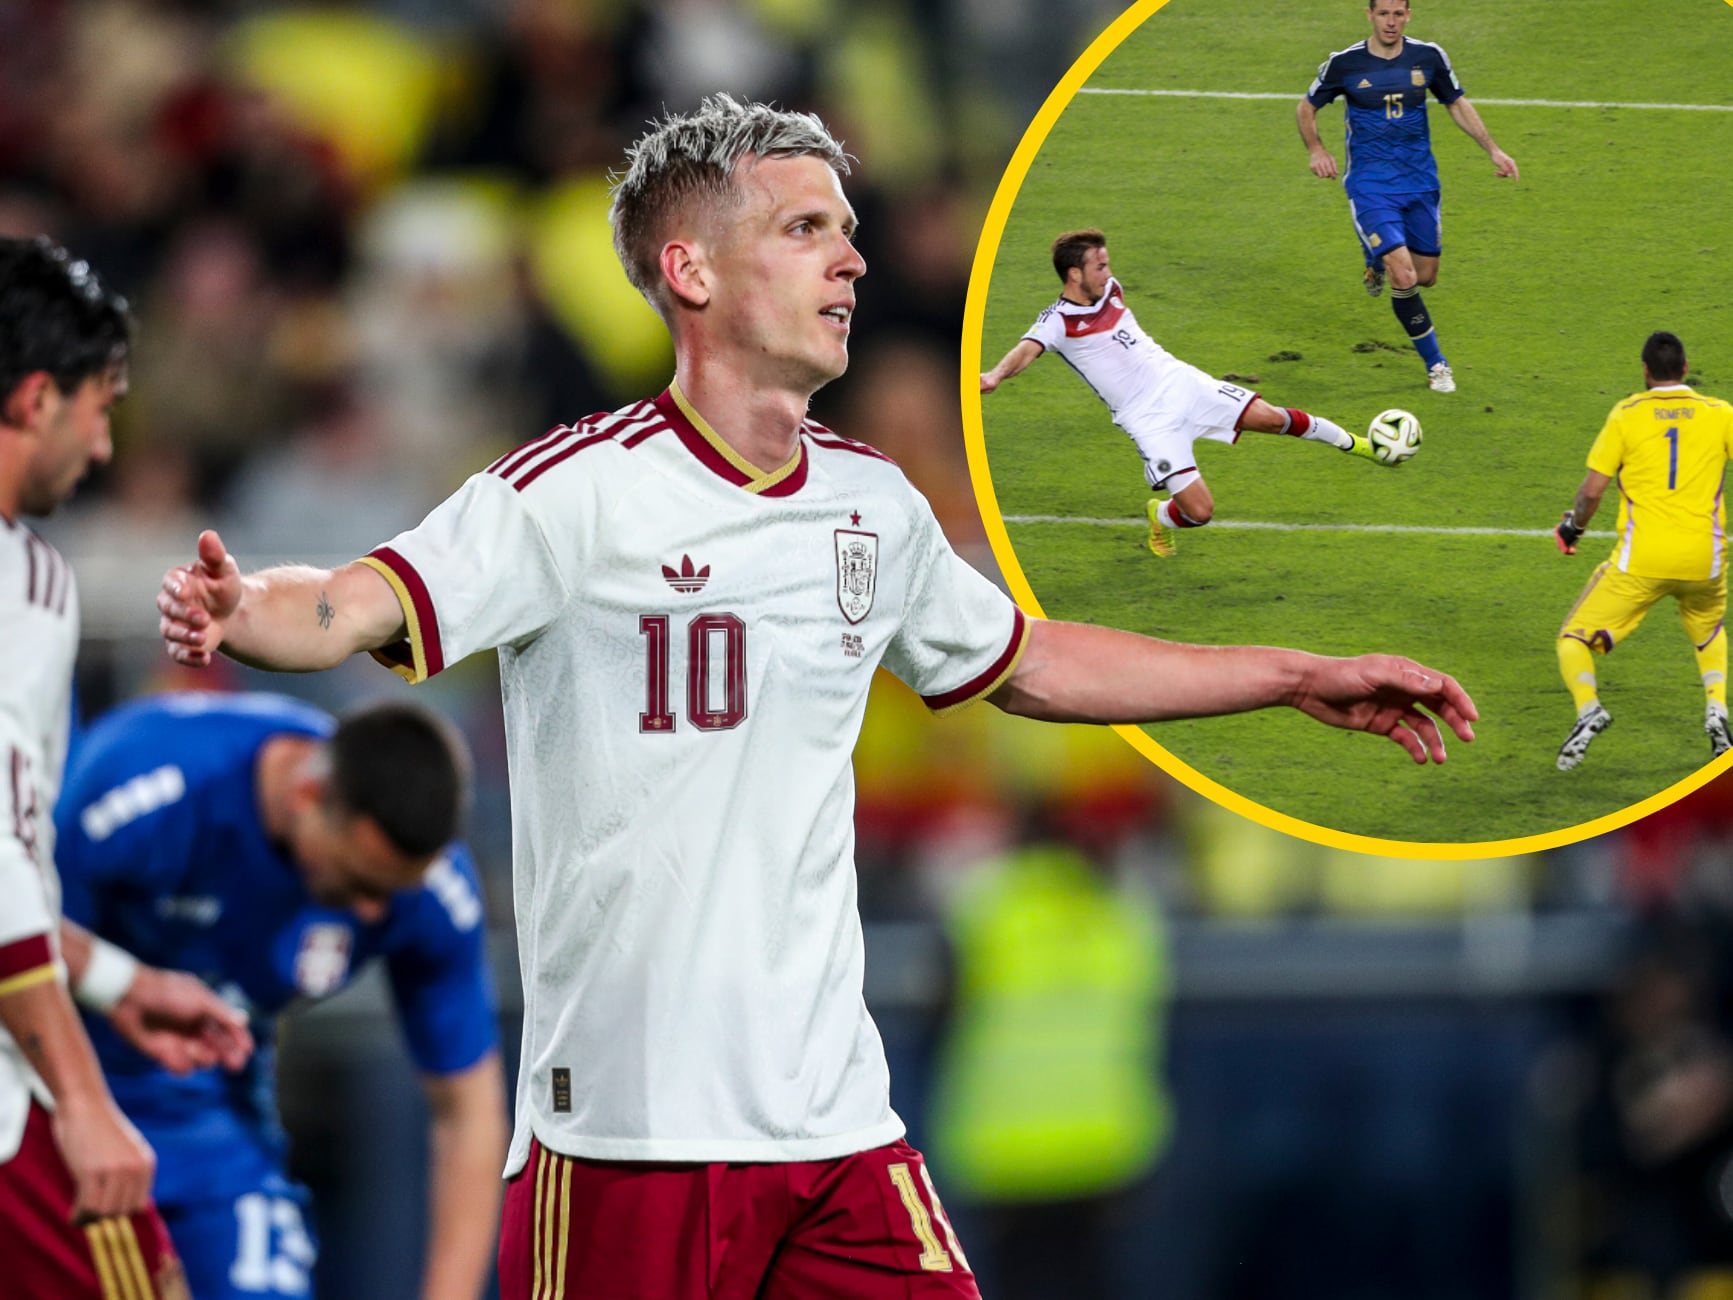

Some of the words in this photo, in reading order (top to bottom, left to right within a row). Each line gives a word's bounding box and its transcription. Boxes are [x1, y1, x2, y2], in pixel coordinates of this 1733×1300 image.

[1383, 93, 1404, 119] 15
[1112, 329, 1137, 350] 19
[1218, 384, 1246, 402] 19
[1653, 407, 1695, 420] ROMERO
[1664, 427, 1679, 490] 1
[639, 612, 748, 733] 10
